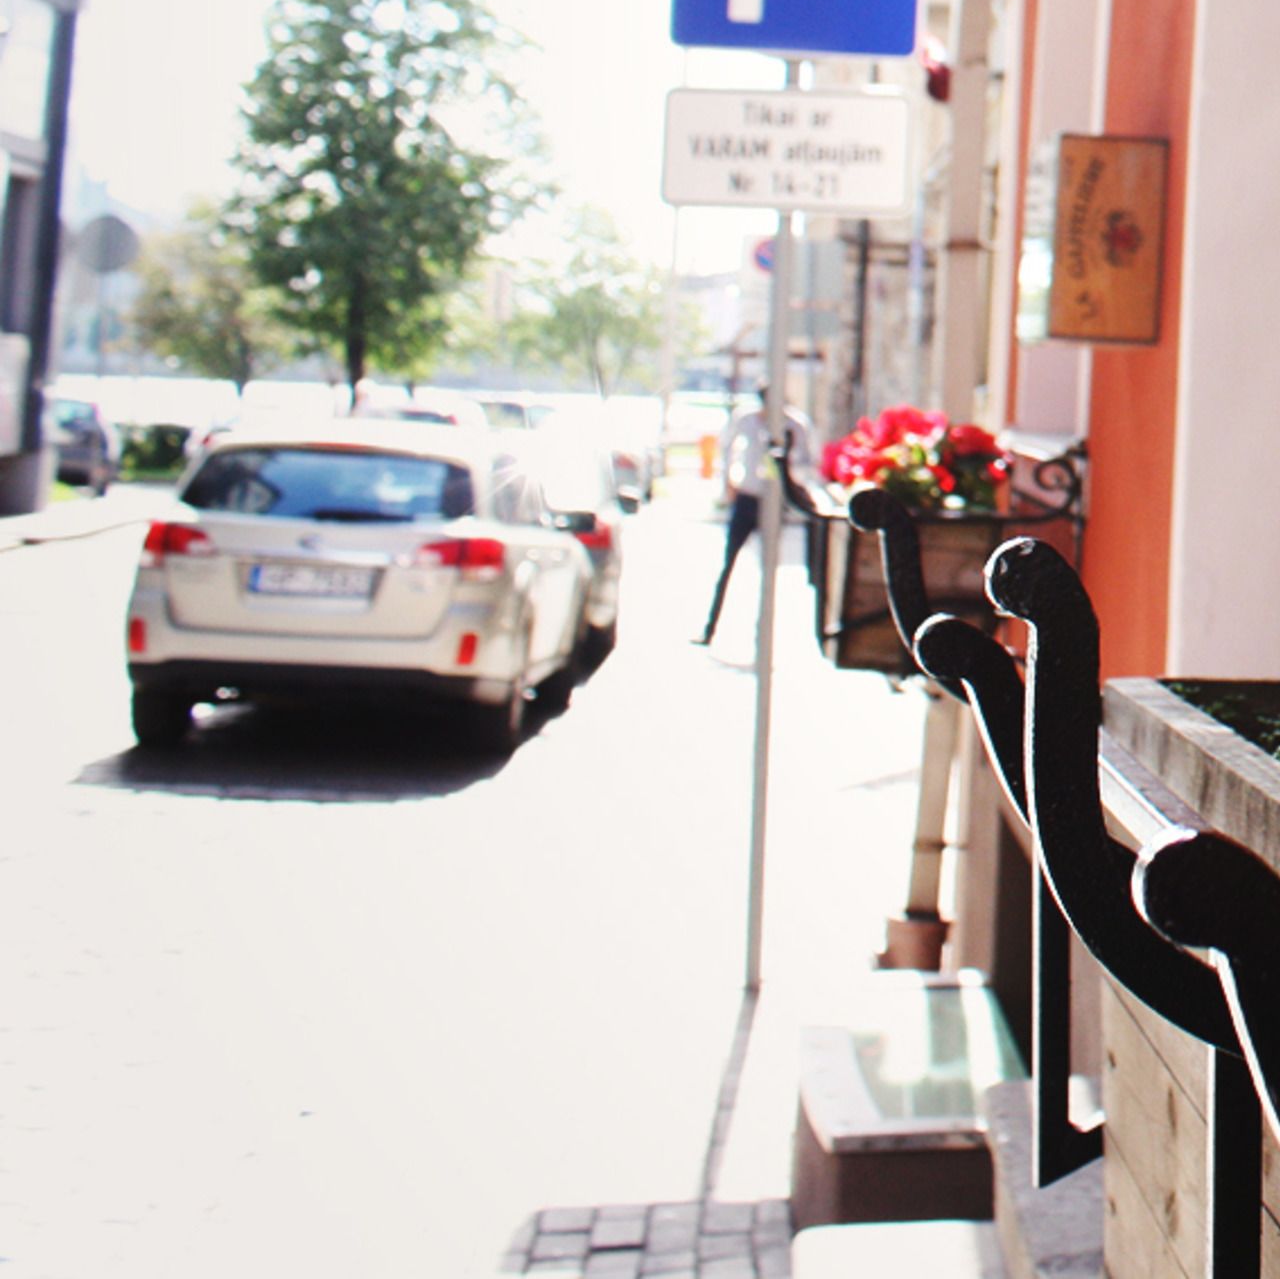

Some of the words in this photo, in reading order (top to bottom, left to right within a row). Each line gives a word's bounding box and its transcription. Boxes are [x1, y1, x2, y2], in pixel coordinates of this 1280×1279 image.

[743, 102, 796, 127] Tikai
[810, 109, 833, 128] ar
[688, 134, 771, 160] VARAM
